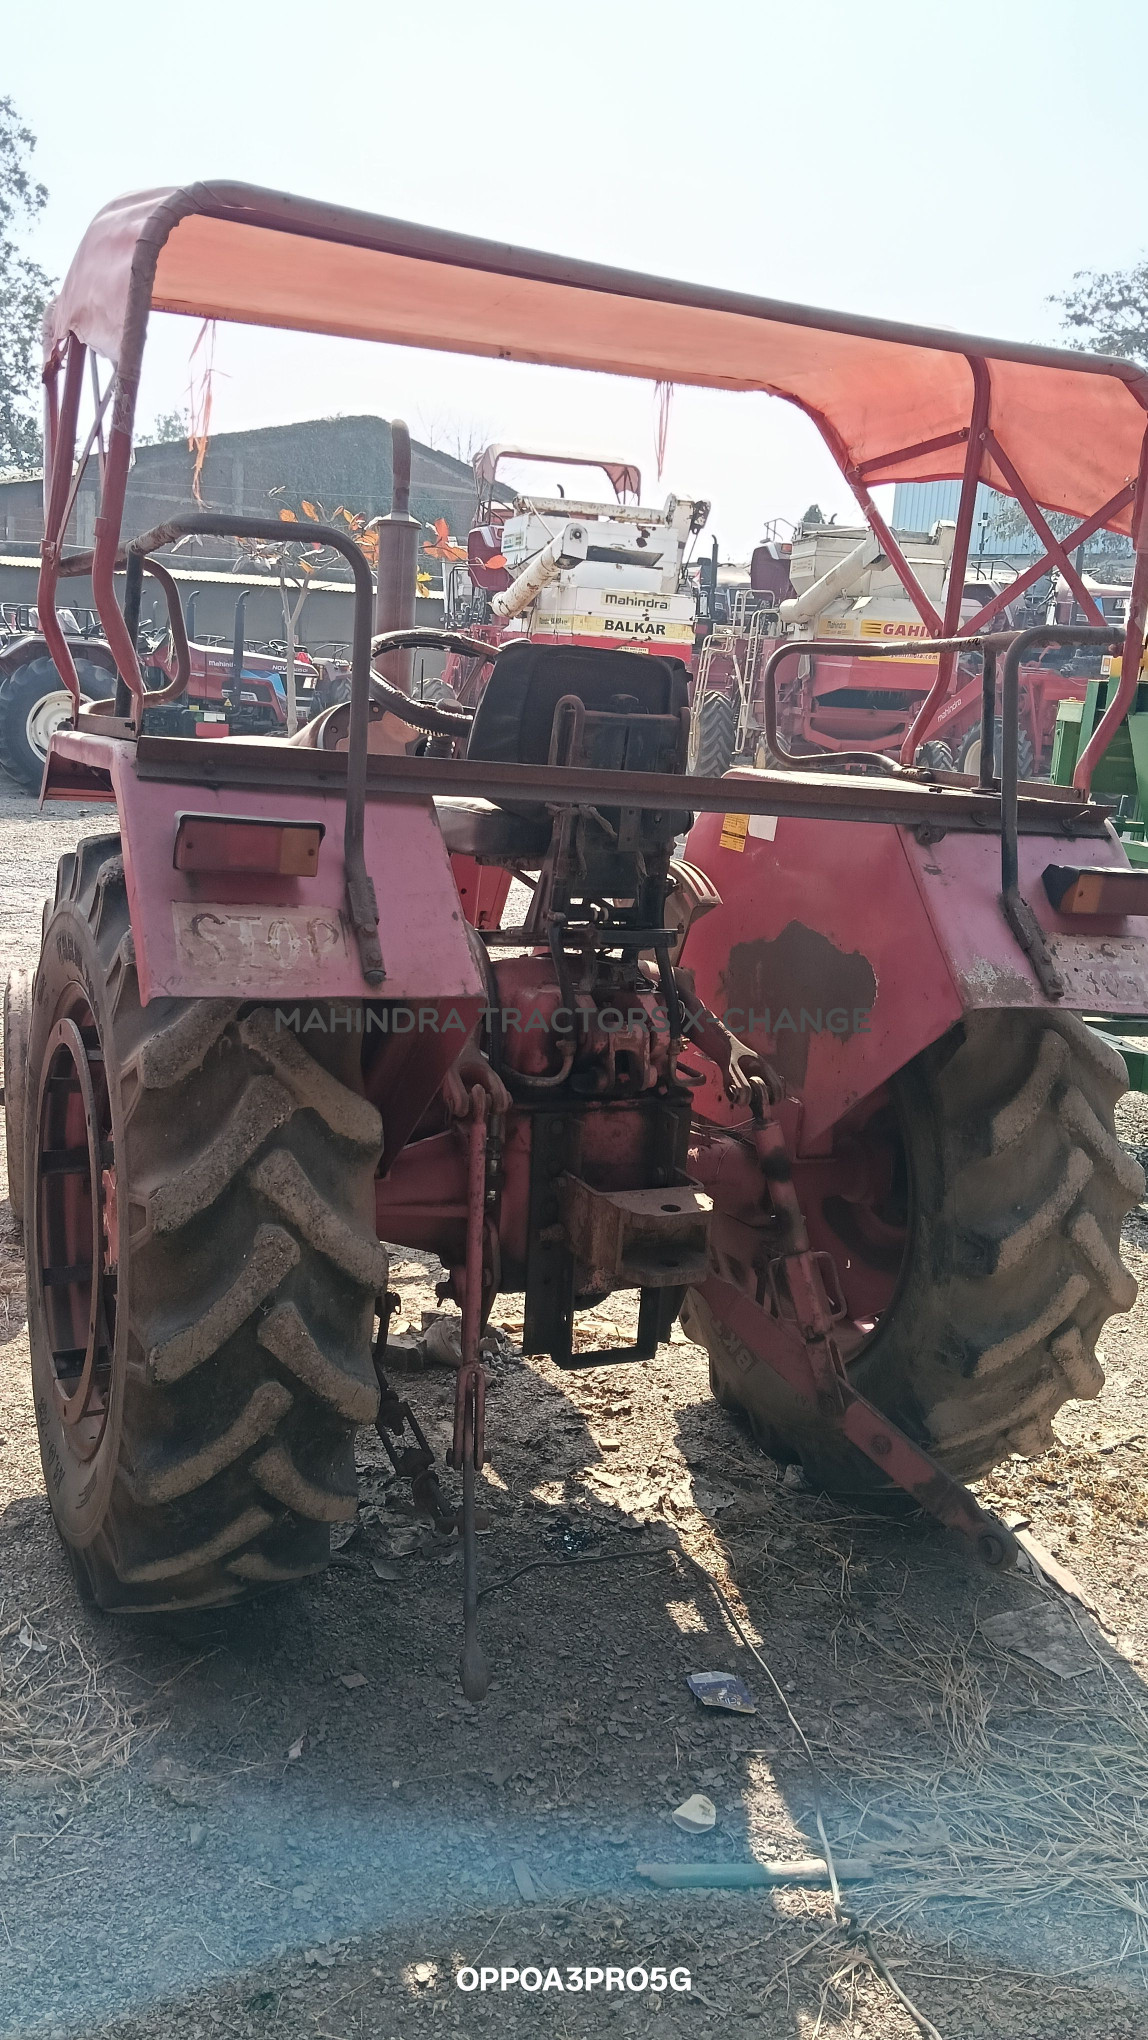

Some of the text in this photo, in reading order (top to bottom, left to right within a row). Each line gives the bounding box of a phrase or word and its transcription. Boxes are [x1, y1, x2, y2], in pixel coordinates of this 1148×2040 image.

[605, 593, 668, 610] Mahindra
[604, 619, 666, 636] BALKAR
[181, 911, 340, 970] STOP
